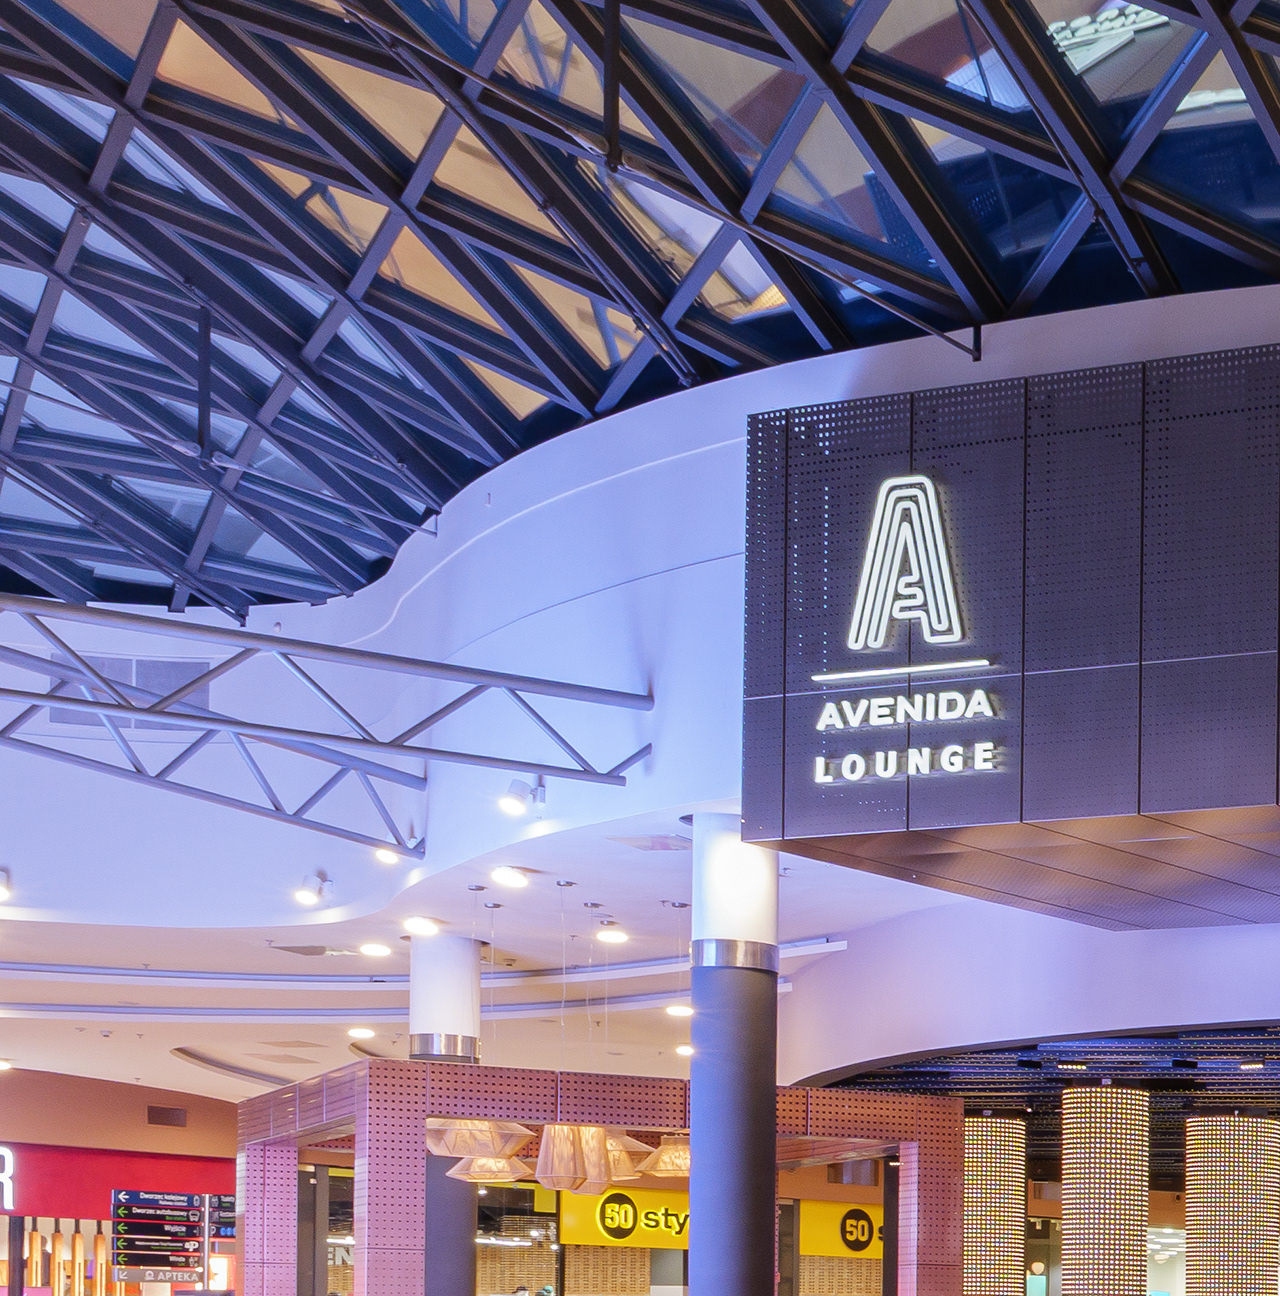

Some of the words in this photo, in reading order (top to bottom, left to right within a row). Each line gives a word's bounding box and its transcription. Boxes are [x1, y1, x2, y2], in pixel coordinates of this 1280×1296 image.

[815, 688, 997, 732] AVENIDA
[814, 741, 998, 784] LOUNGE
[604, 1203, 633, 1230] 50
[846, 1219, 868, 1242] 50
[158, 1271, 199, 1282] APTEKA
